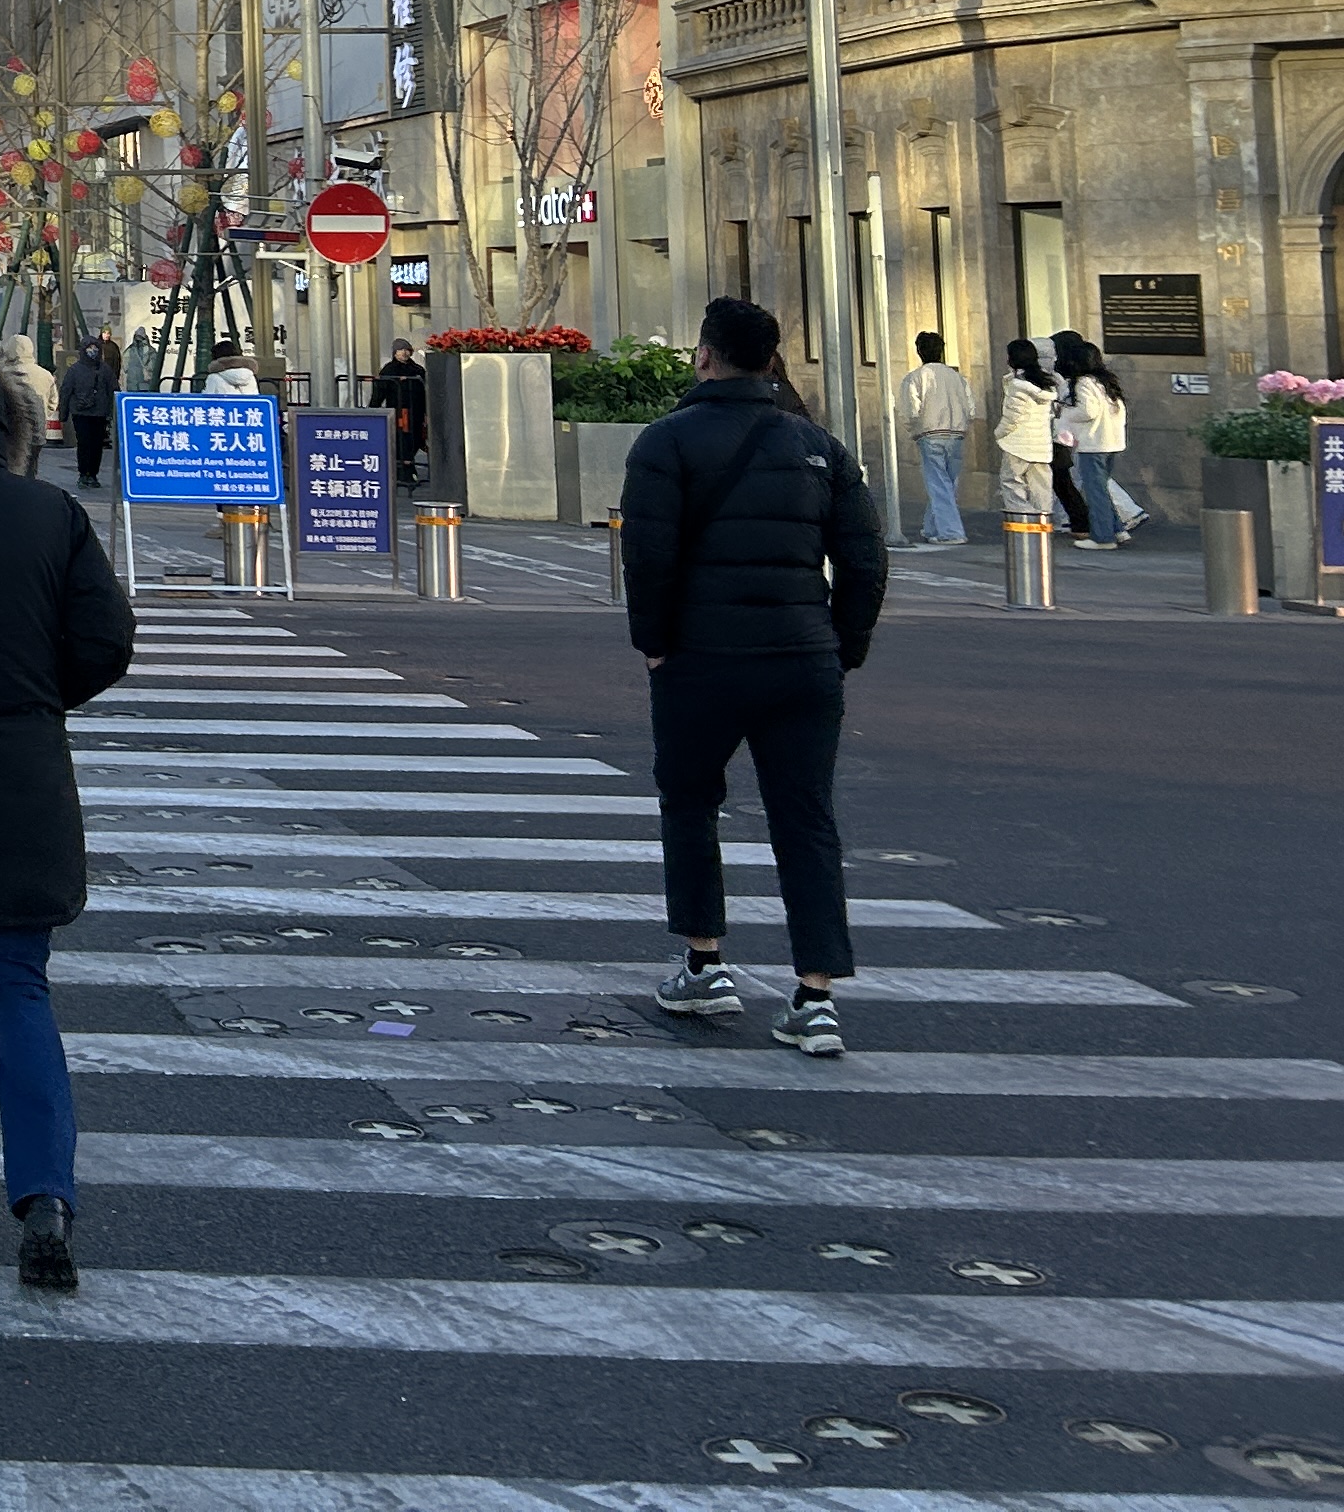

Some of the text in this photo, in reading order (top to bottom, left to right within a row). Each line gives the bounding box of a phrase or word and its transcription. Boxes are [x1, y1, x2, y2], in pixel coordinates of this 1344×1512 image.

[133, 405, 264, 427] 未经批准禁止放
[134, 431, 266, 452] 飞航模、无人机
[135, 456, 154, 466] Only
[156, 457, 202, 466] Authorized
[204, 457, 223, 466] Aero
[225, 458, 256, 467] Models
[310, 453, 380, 472] 禁止一切
[135, 468, 269, 480] Drones Allowed To Be Launched
[1325, 468, 1344, 493] 禁
[310, 479, 381, 498] 车辆通行
